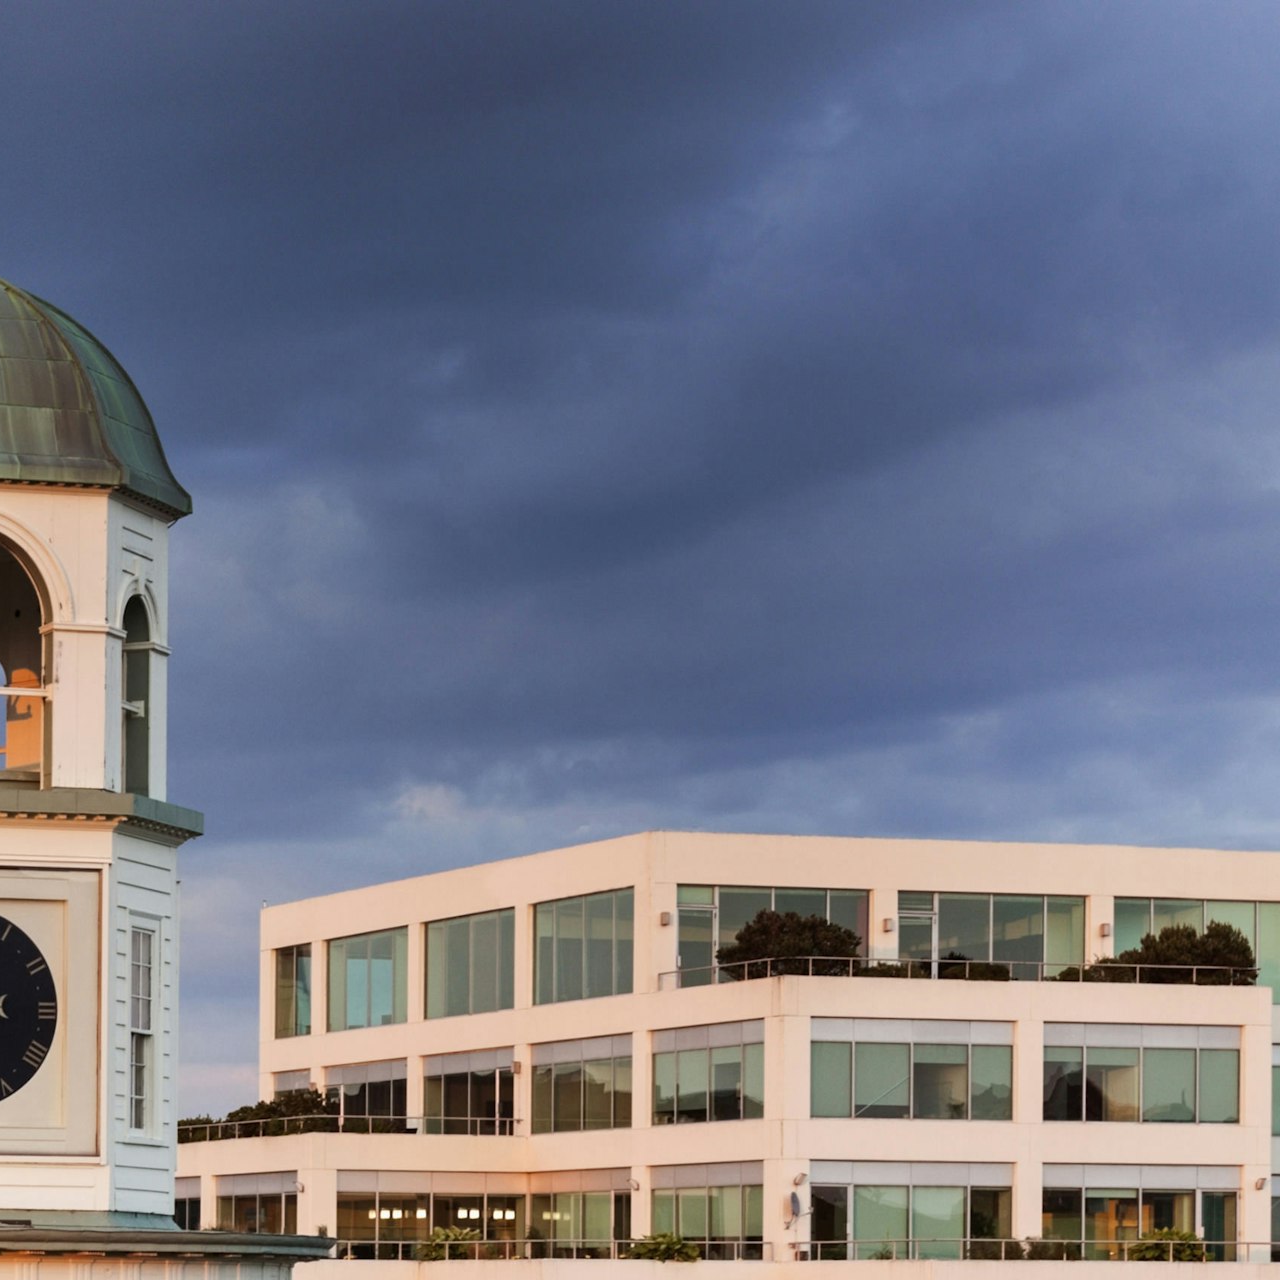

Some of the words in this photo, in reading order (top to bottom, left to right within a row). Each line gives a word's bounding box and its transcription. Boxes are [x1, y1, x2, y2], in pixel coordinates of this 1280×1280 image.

[26, 957, 47, 975] II
[38, 1001, 56, 1020] III
[0, 1077, 14, 1097] V
